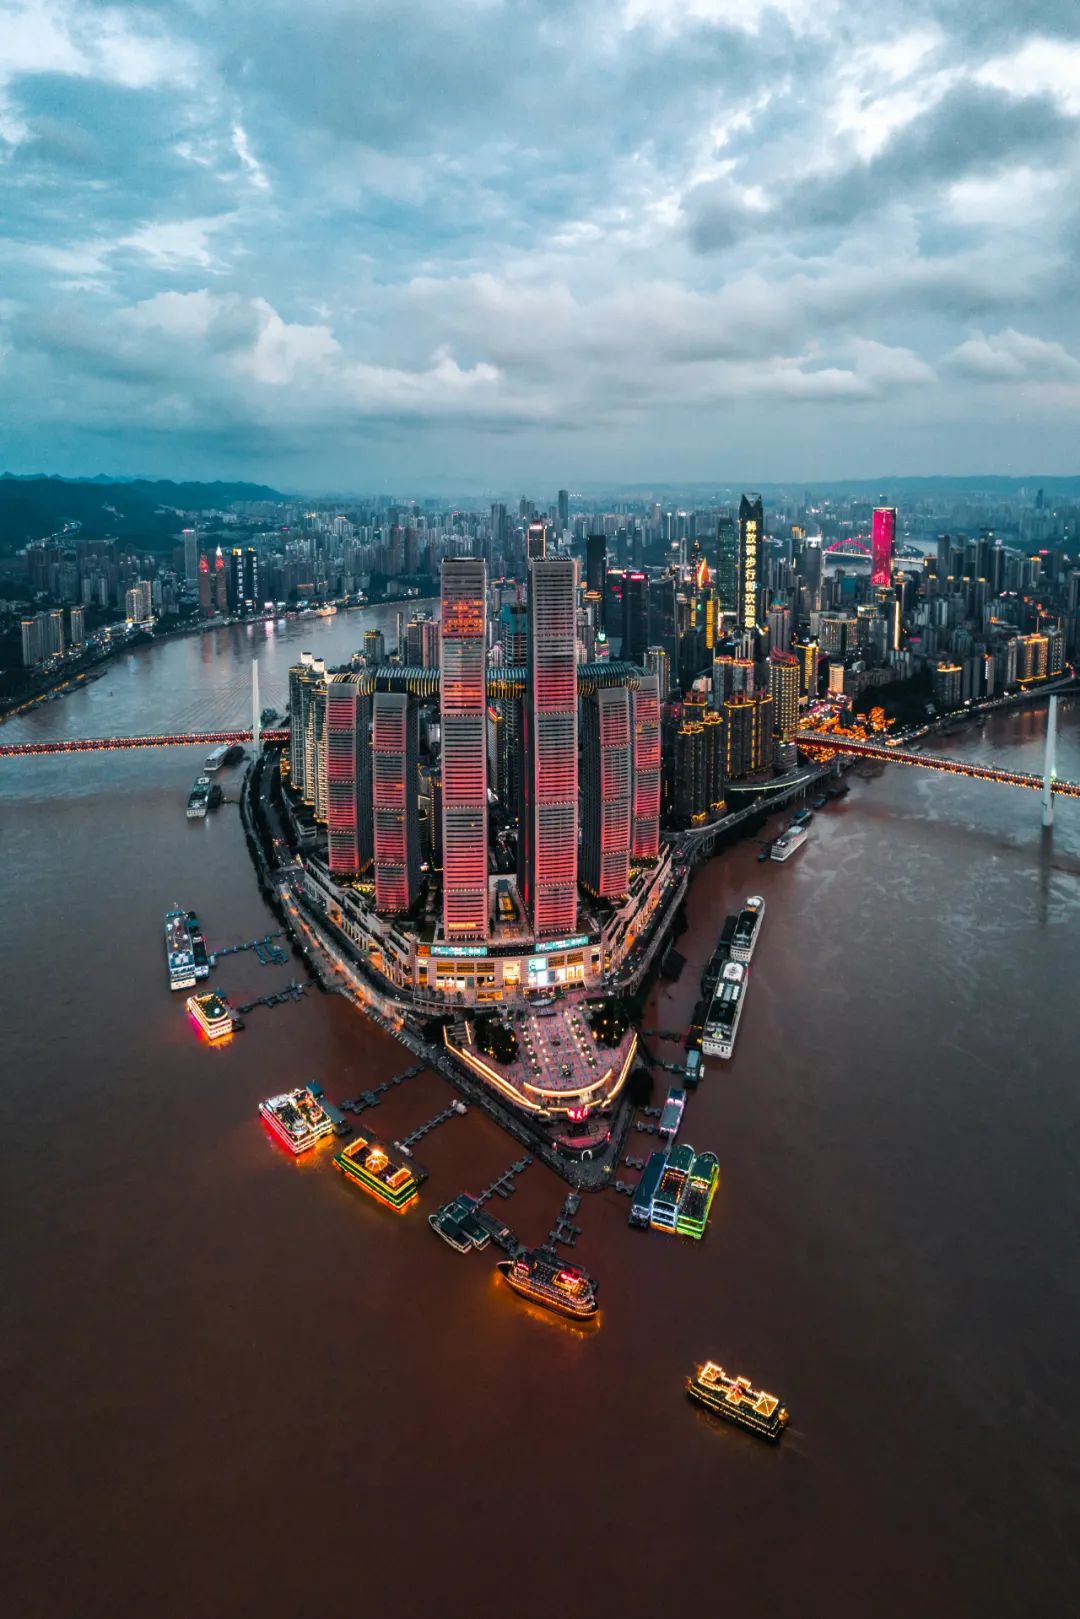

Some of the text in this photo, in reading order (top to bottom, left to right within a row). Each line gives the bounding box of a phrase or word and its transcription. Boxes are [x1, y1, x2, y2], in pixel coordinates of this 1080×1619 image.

[744, 520, 757, 628] 解放碑步行街欢迎您
